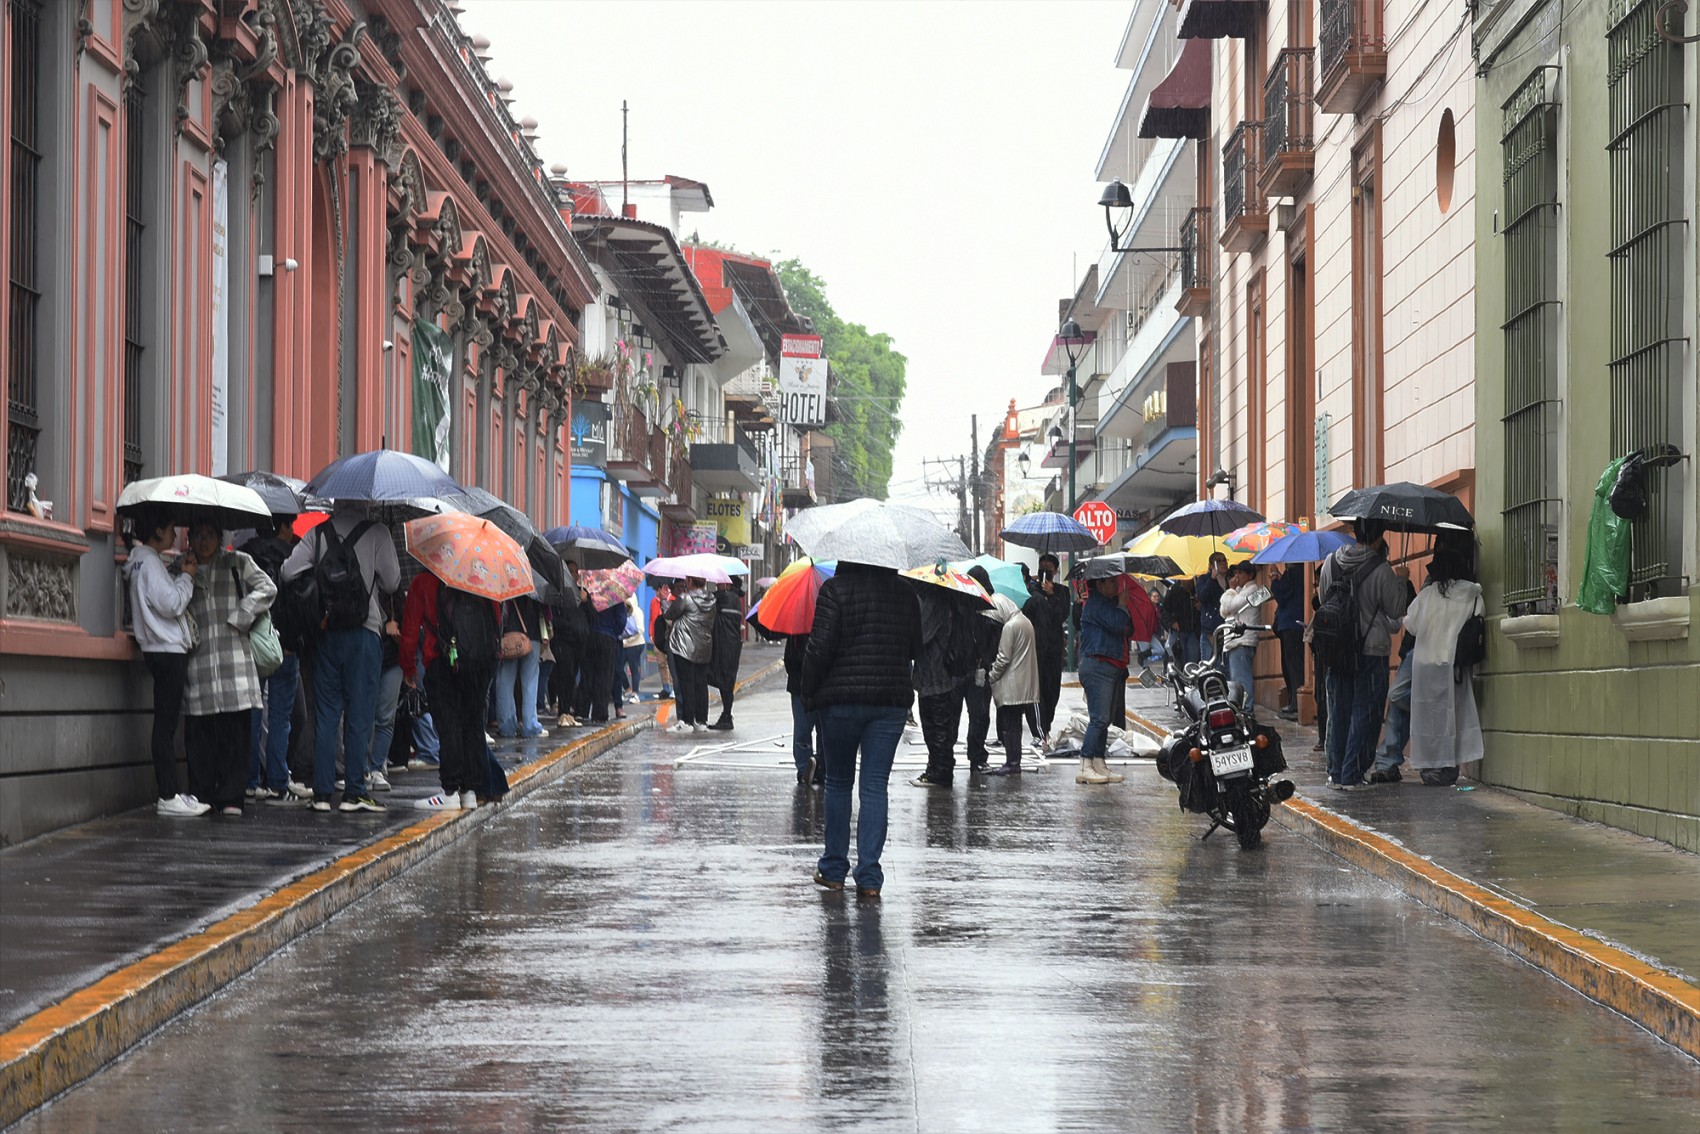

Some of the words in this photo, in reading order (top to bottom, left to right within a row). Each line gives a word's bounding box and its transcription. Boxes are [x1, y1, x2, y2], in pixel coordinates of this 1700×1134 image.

[780, 393, 823, 423] HOTEL
[707, 503, 741, 517] ELOTES
[1381, 505, 1414, 517] NICE
[1078, 510, 1113, 527] ALTO
[1090, 528, 1104, 540] X1
[1215, 751, 1249, 768] 54YSV8
